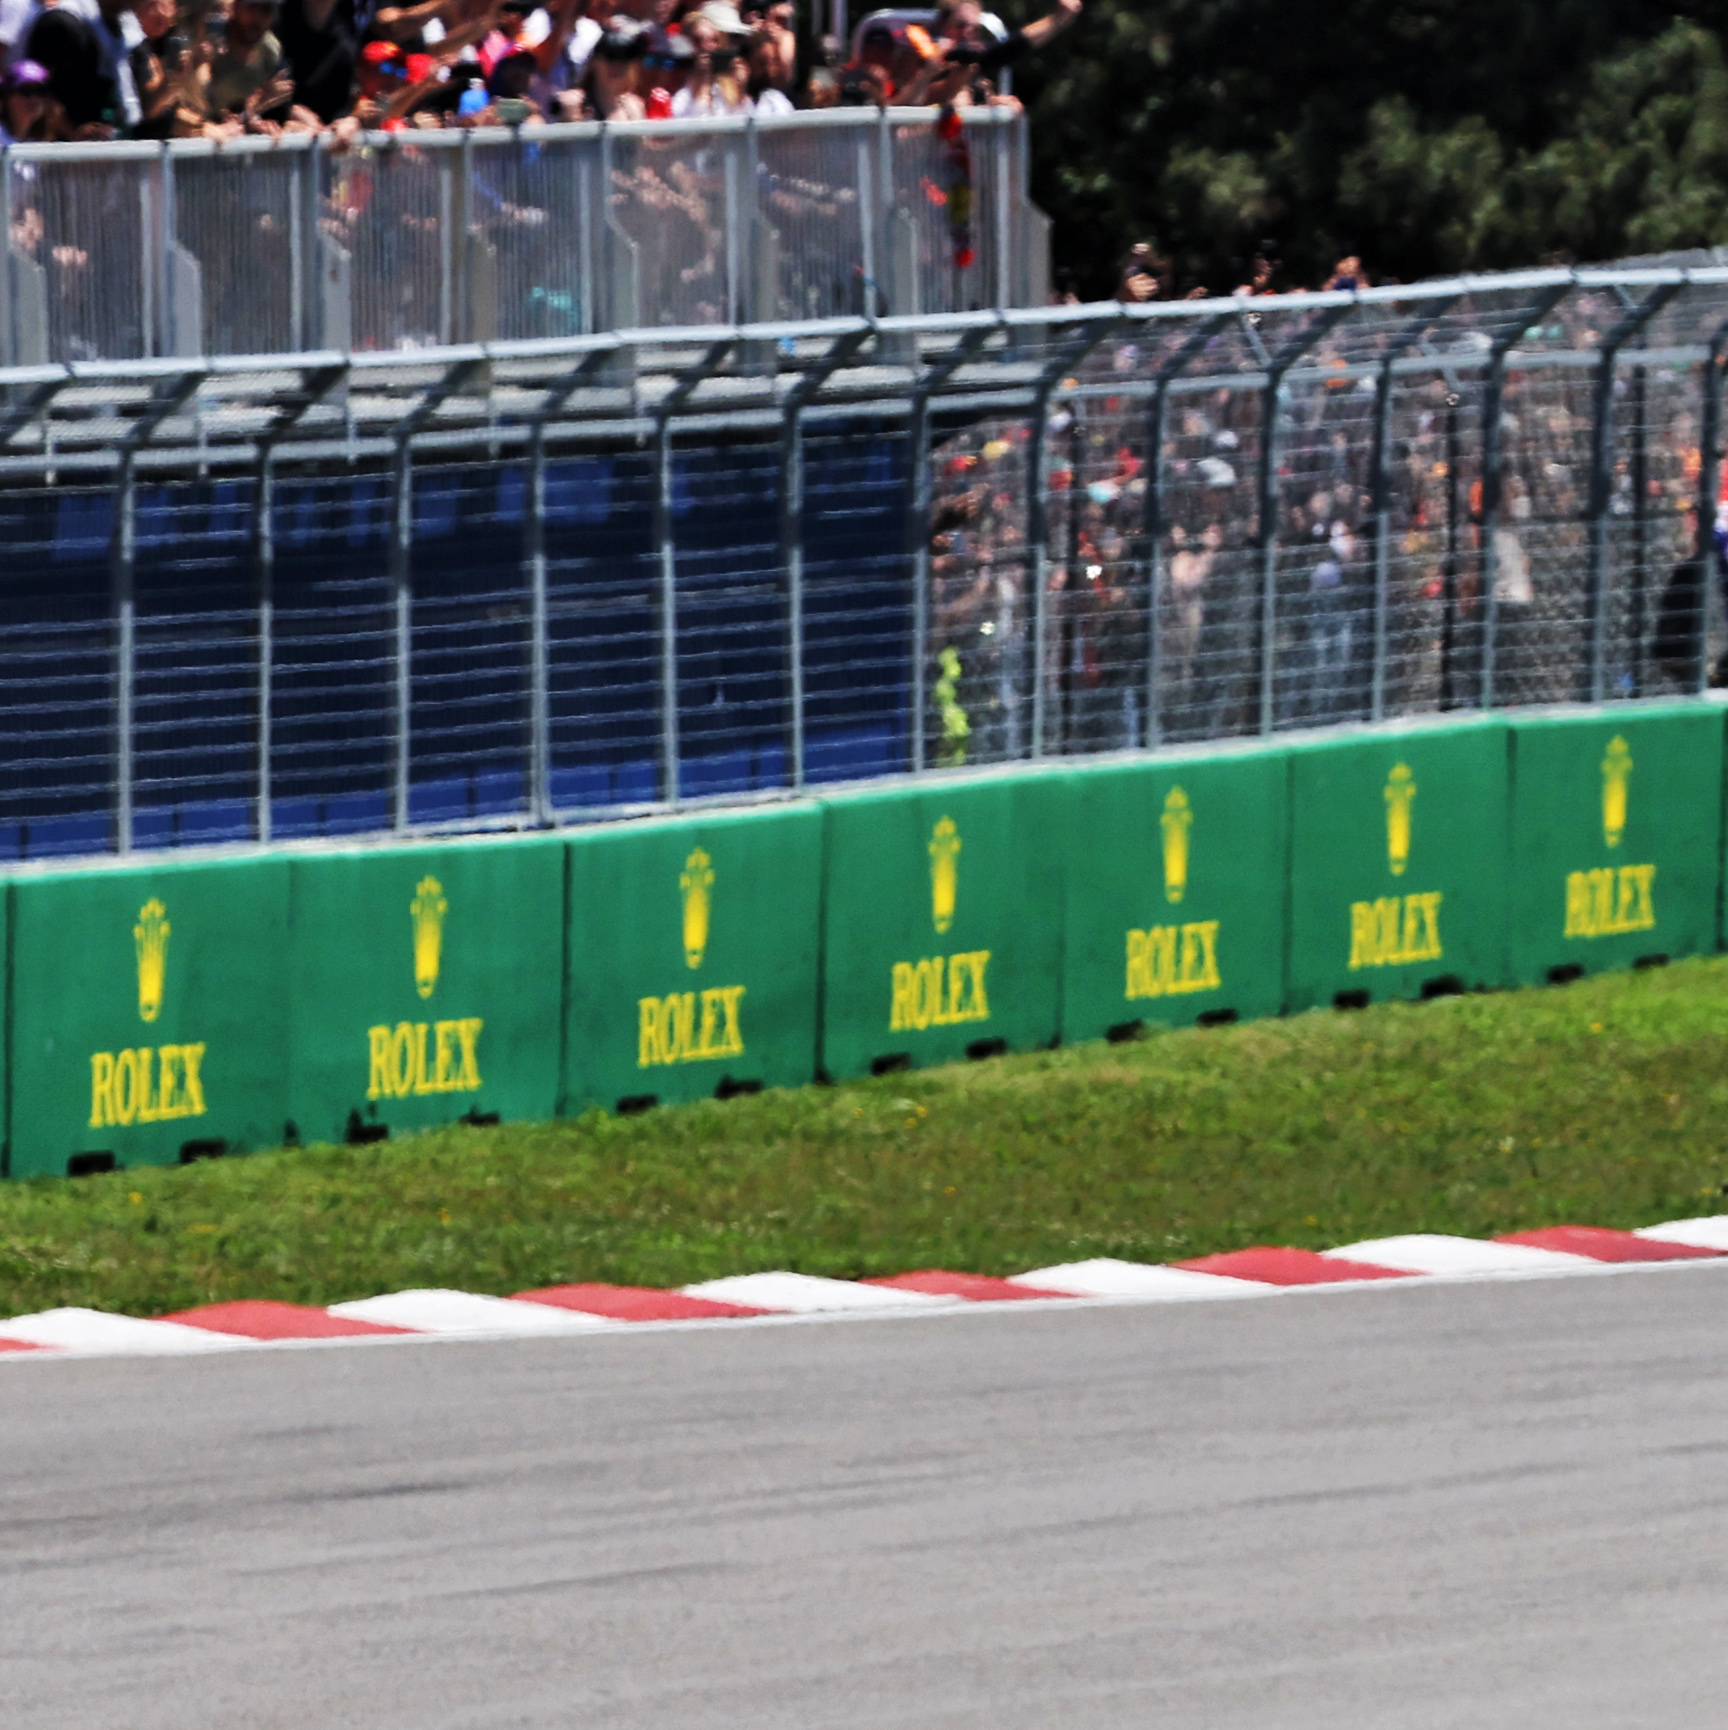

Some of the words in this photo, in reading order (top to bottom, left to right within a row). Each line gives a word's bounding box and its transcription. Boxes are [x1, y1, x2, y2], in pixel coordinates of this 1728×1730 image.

[1348, 892, 1443, 969] ROLEX
[1565, 864, 1656, 939] ROLEX
[890, 950, 991, 1032] ROLEX
[1126, 920, 1220, 999] ROLEX
[368, 1018, 482, 1099] ROLEX
[638, 986, 746, 1068] ROLEX
[90, 1042, 206, 1127] ROLEX
